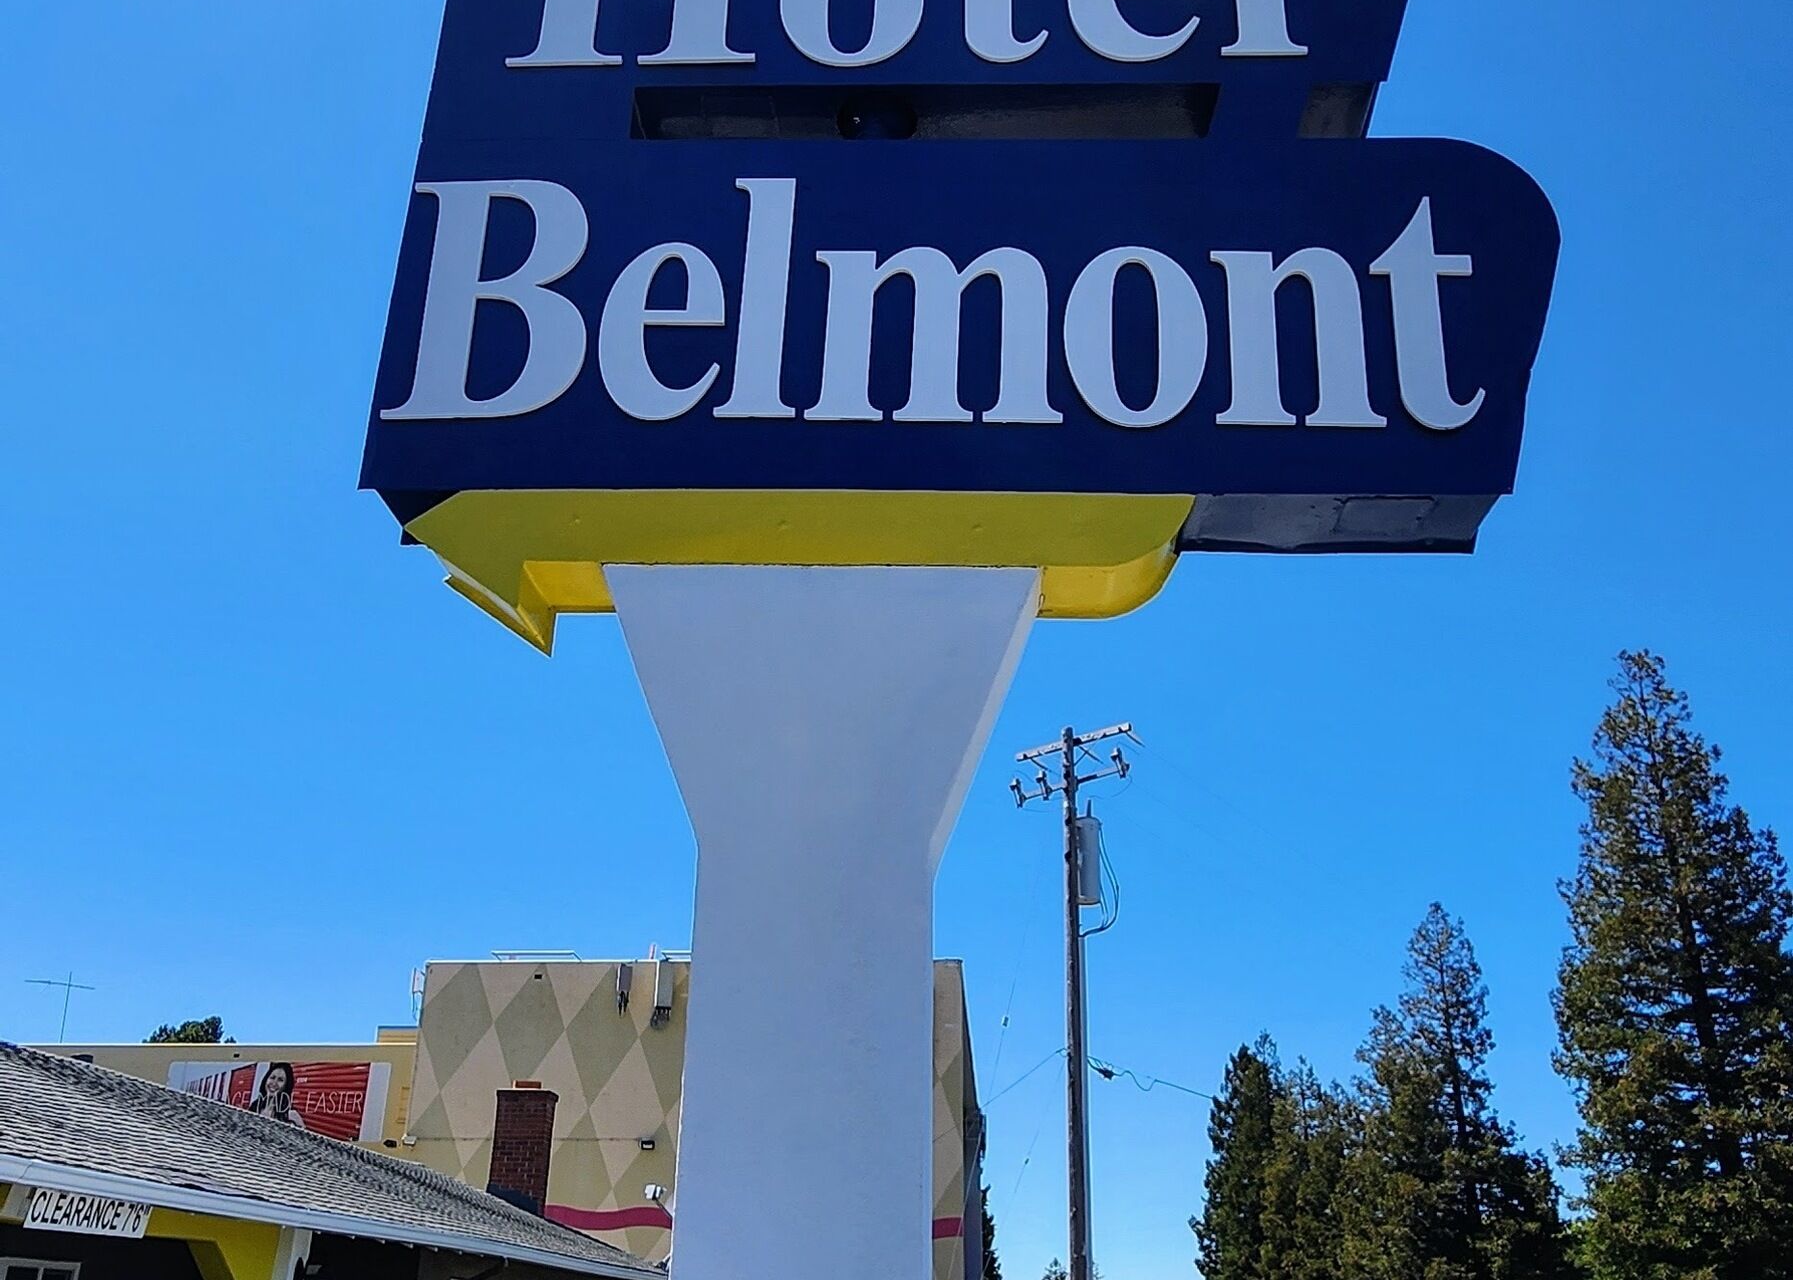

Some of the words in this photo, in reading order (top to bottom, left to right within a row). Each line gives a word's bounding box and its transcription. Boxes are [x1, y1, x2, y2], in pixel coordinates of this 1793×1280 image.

[380, 177, 1486, 429] Belmont
[227, 1091, 251, 1109] CE
[257, 1091, 300, 1114] MADE
[305, 1091, 363, 1114] EASIER
[30, 1190, 125, 1231] CLEARANCE
[121, 1203, 151, 1233] 7'6"
